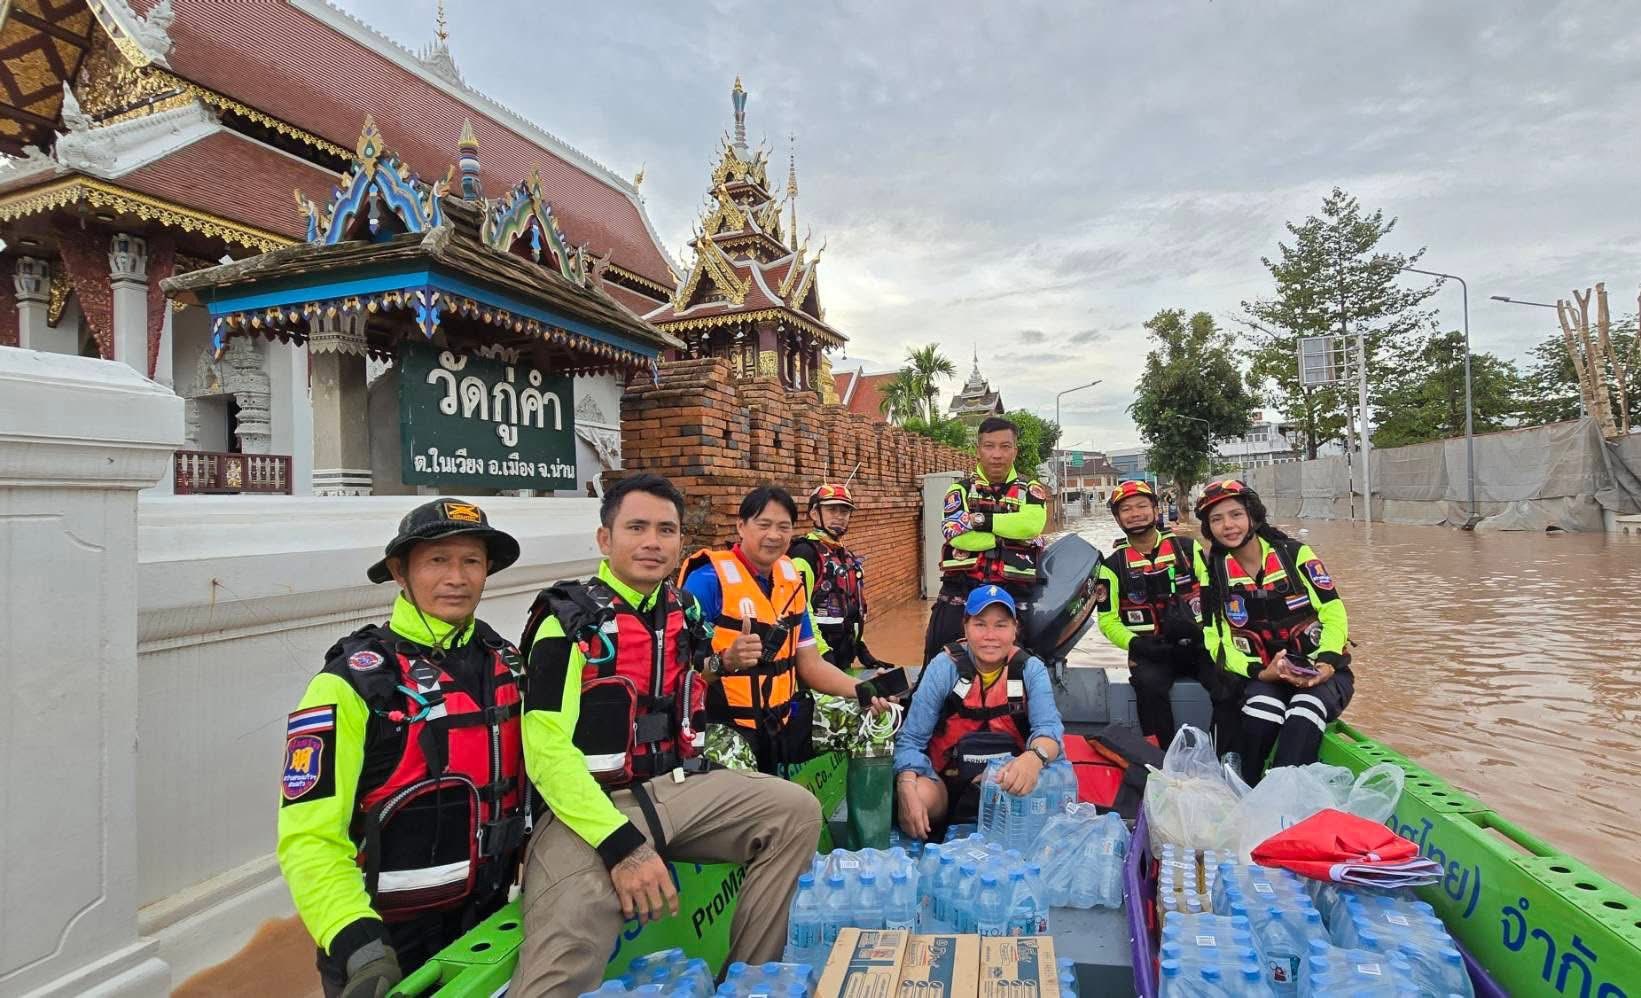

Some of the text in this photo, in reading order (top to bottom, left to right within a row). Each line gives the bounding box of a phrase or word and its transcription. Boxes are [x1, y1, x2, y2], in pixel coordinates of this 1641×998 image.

[426, 350, 562, 447] วัดกู่คำ
[414, 447, 575, 479] ต.ในเวียง อ.เมือง จ.น่าน
[691, 863, 749, 939] ProMa
